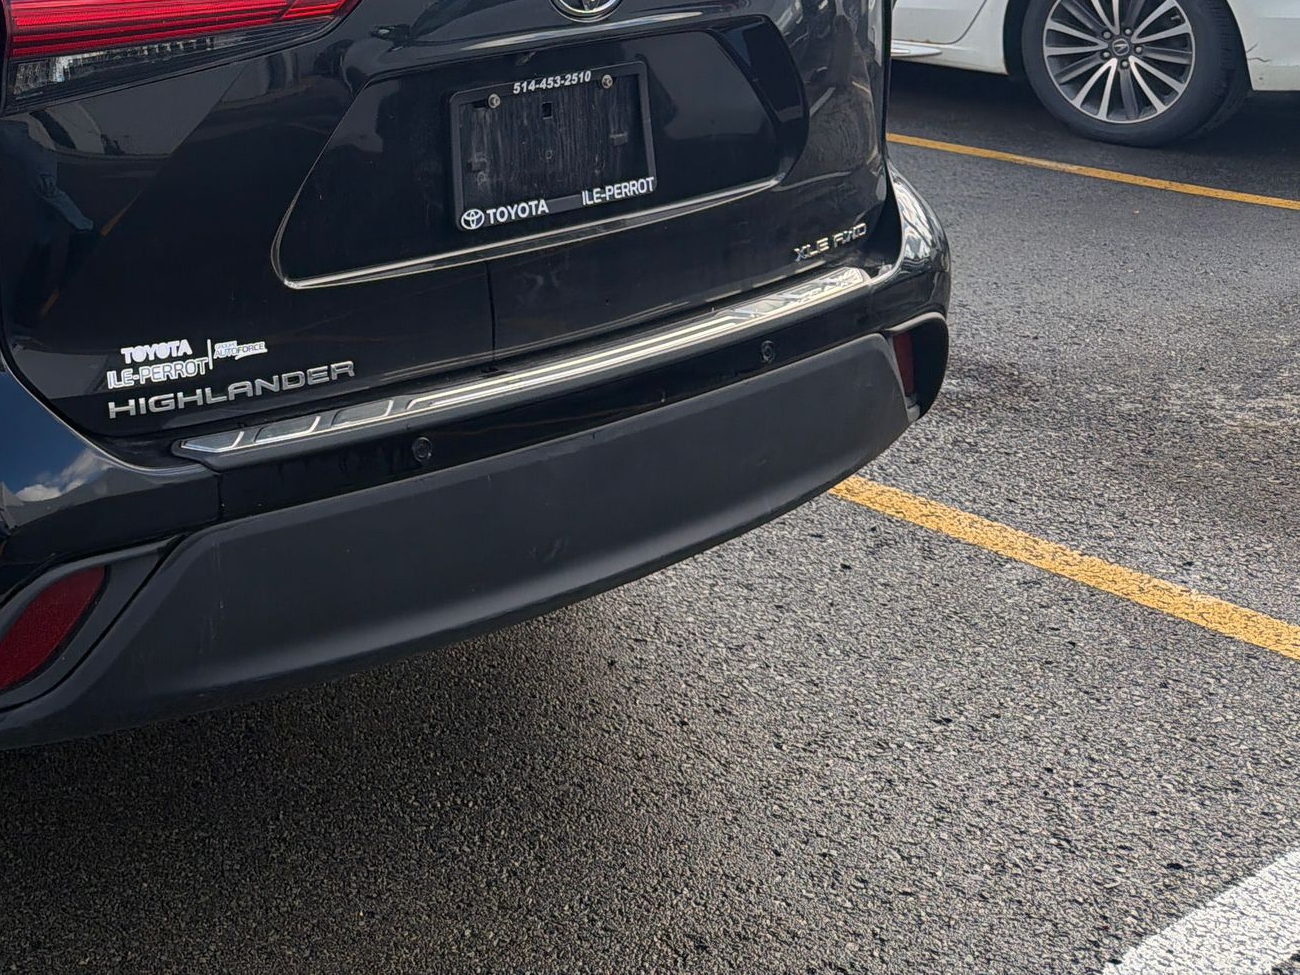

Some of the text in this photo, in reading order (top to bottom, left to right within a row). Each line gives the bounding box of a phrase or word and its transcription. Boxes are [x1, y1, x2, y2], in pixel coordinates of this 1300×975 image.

[512, 70, 592, 95] 514-453-2510
[486, 176, 655, 225] TOYOTA ILE-PERROT
[793, 237, 830, 263] XLE
[120, 339, 193, 365] TOYOTA
[215, 342, 266, 357] AUTOFORCE
[106, 356, 209, 390] ILE-PERROT
[107, 360, 356, 419] HIGHLANDER
